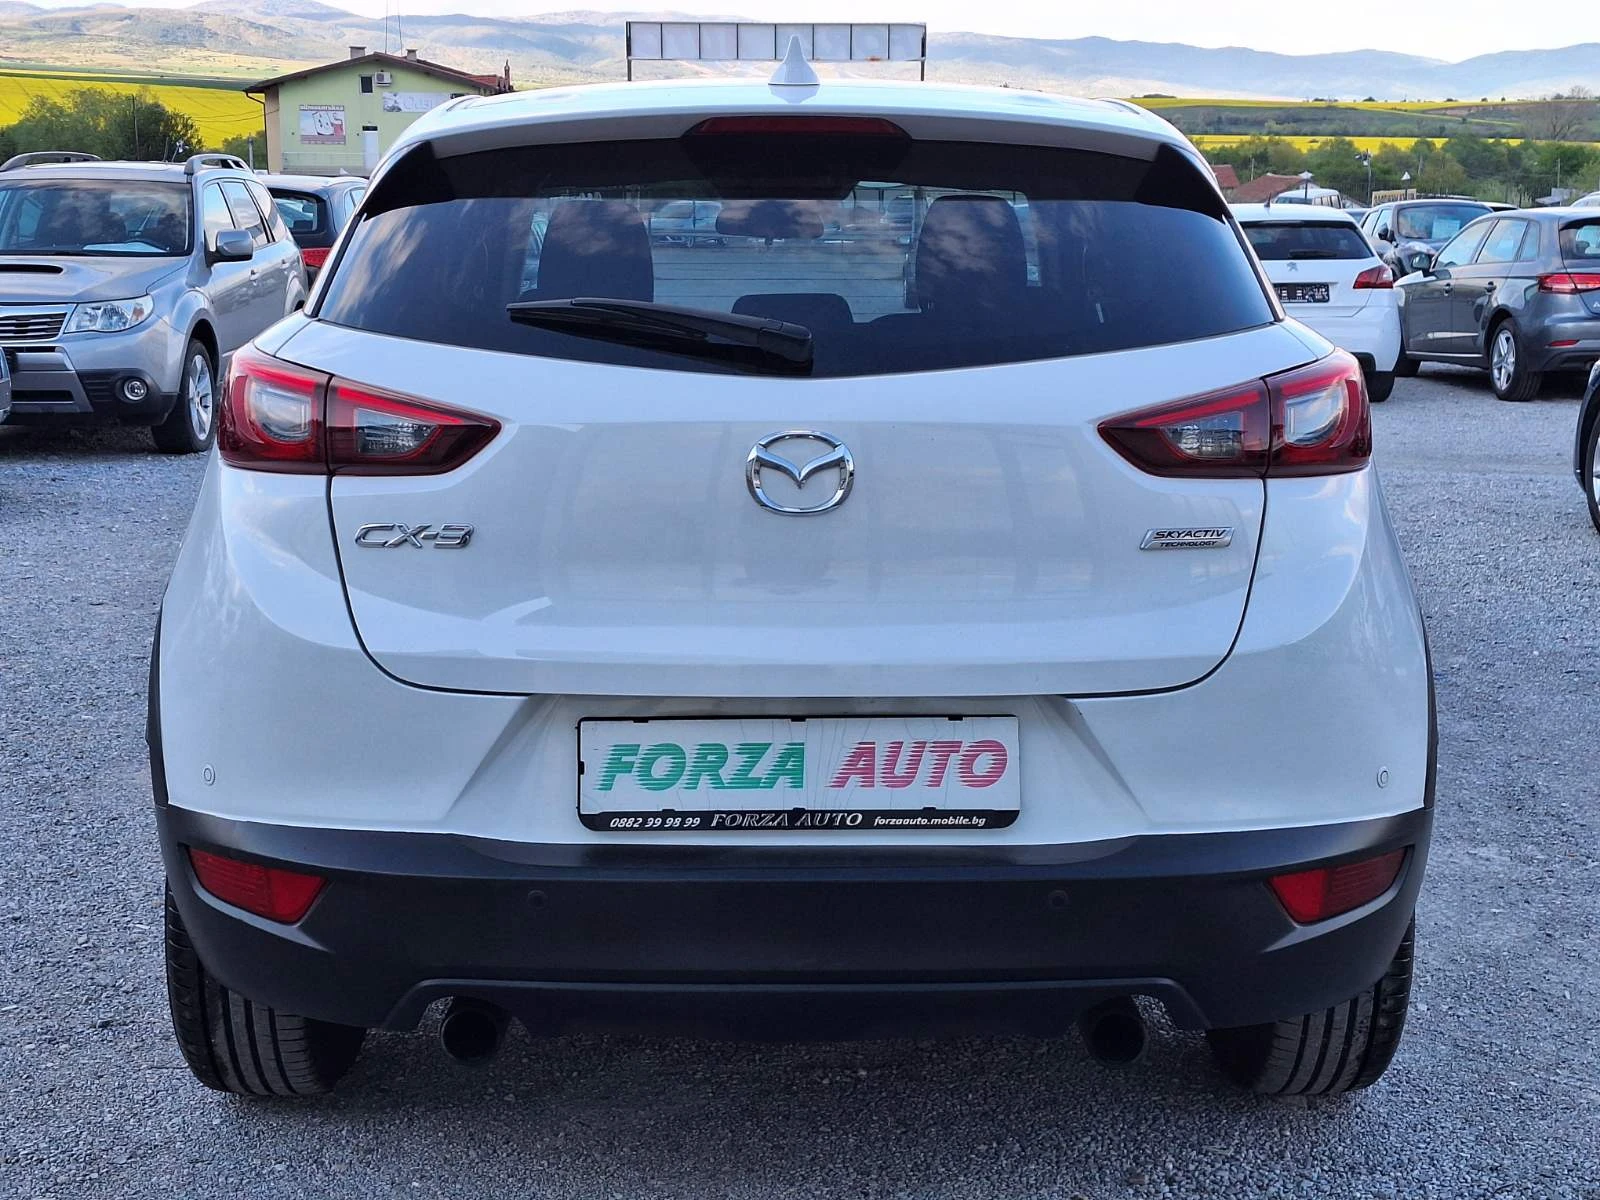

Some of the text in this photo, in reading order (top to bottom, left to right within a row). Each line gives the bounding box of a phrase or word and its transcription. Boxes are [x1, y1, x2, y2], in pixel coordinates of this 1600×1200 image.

[355, 523, 475, 548] CX-3
[1153, 529, 1227, 539] SKYACTIV
[1160, 540, 1217, 548] TECHNOLOGY
[594, 739, 1008, 792] FORZA AUTO
[609, 812, 987, 828] 0882 99 98 99 FORZA AUTO forzaauto.mobile.bg
